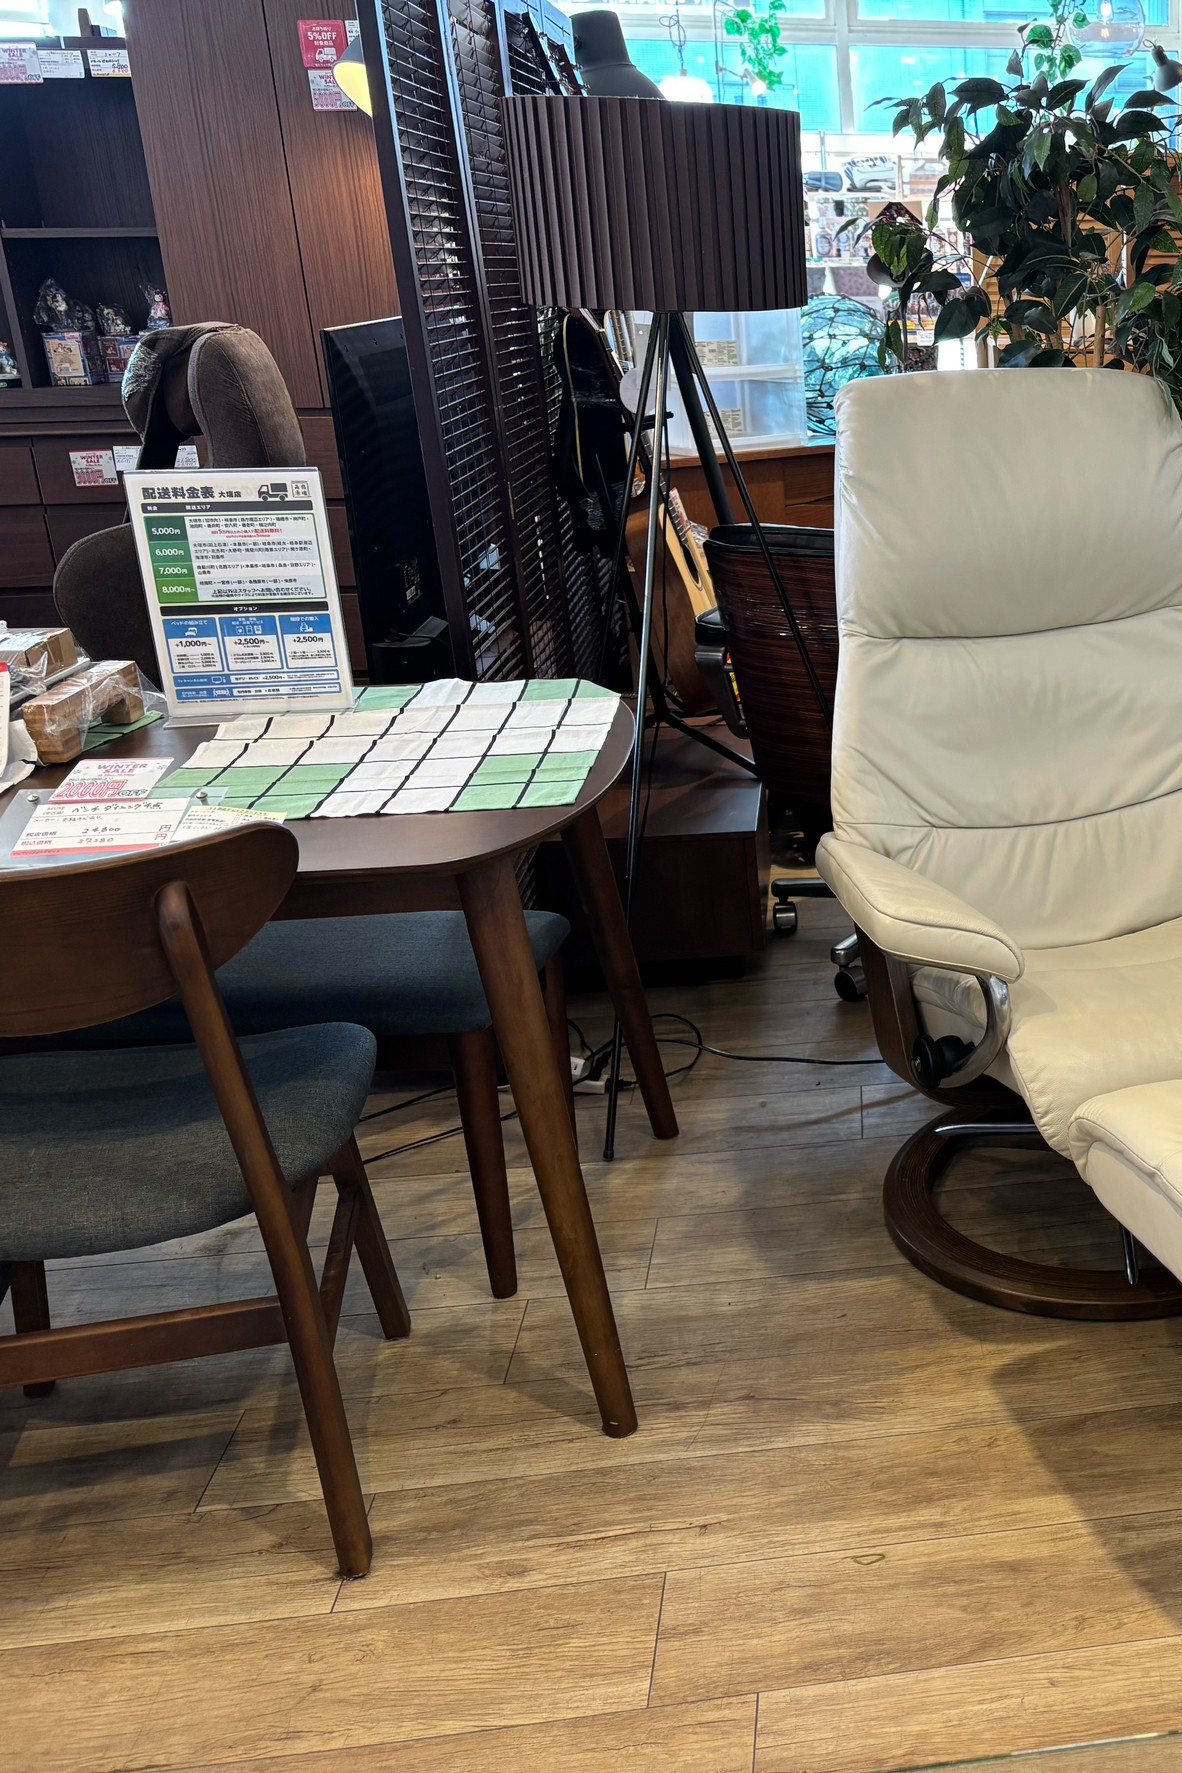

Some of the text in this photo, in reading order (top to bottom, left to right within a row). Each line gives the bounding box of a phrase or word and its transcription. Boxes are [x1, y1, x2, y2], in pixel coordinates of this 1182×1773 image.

[308, 32, 336, 40] 5%OFF
[141, 485, 215, 499] 配送料金表
[155, 548, 184, 556] 6,000円
[292, 635, 323, 643] +2,500円
[53, 779, 149, 799] 2000円 OFF
